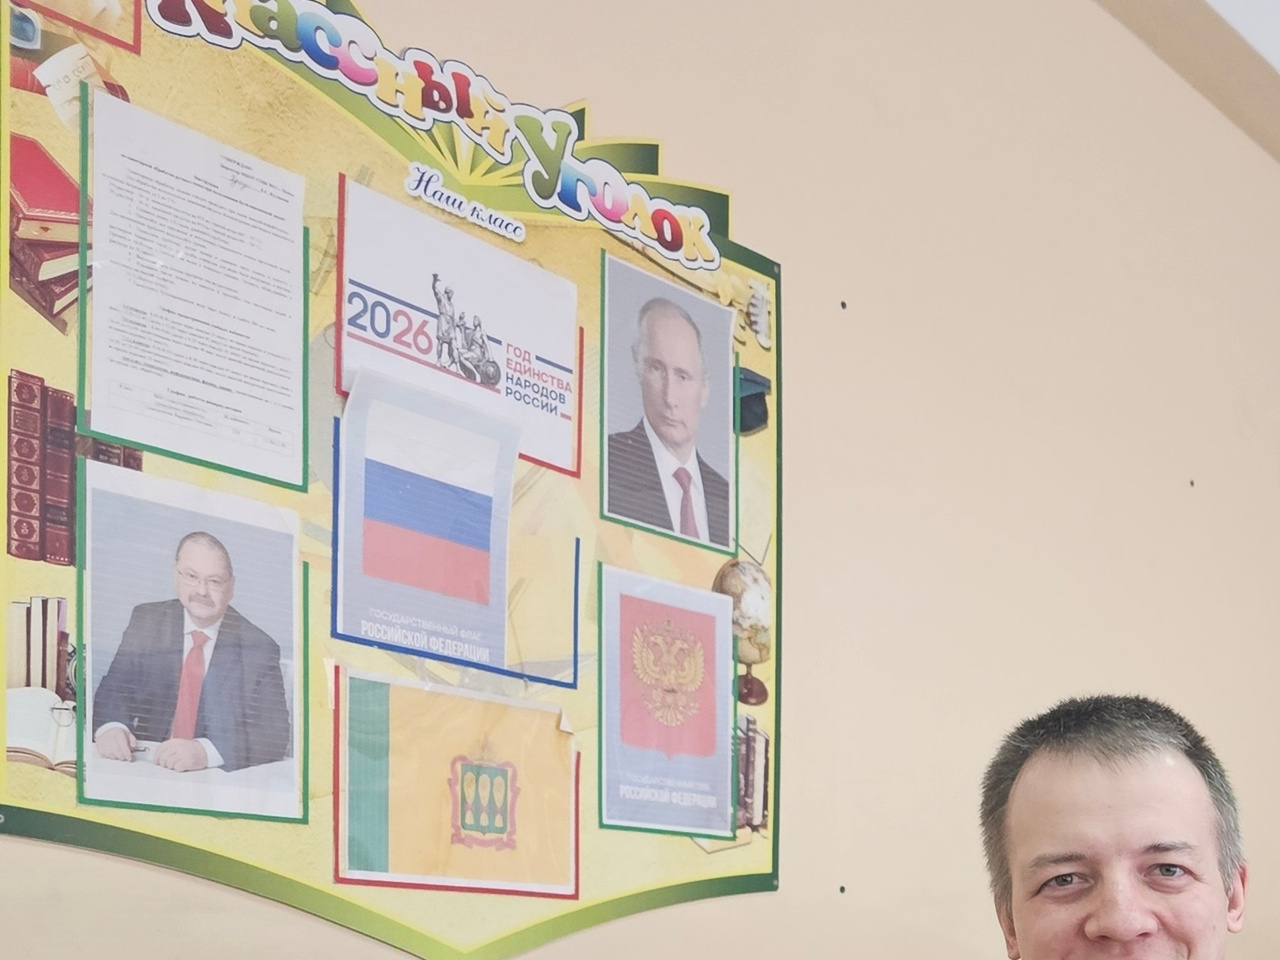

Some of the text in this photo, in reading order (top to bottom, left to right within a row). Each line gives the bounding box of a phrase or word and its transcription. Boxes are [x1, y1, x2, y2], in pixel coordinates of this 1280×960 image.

[408, 166, 524, 239] Наш класс
[514, 112, 717, 263] Уголок
[347, 290, 434, 356] 2026
[505, 342, 533, 364] ГОД
[505, 359, 573, 394] ЕДИНСТВА
[505, 371, 567, 405] НАРОДОВ
[505, 387, 559, 417] РОССИИ
[360, 619, 490, 663] РОССИЙСКОЙ ФЕДЕРАЦИИ
[369, 607, 482, 642] ГОСУДАРСТВЕННЫЙ ФЛАГ
